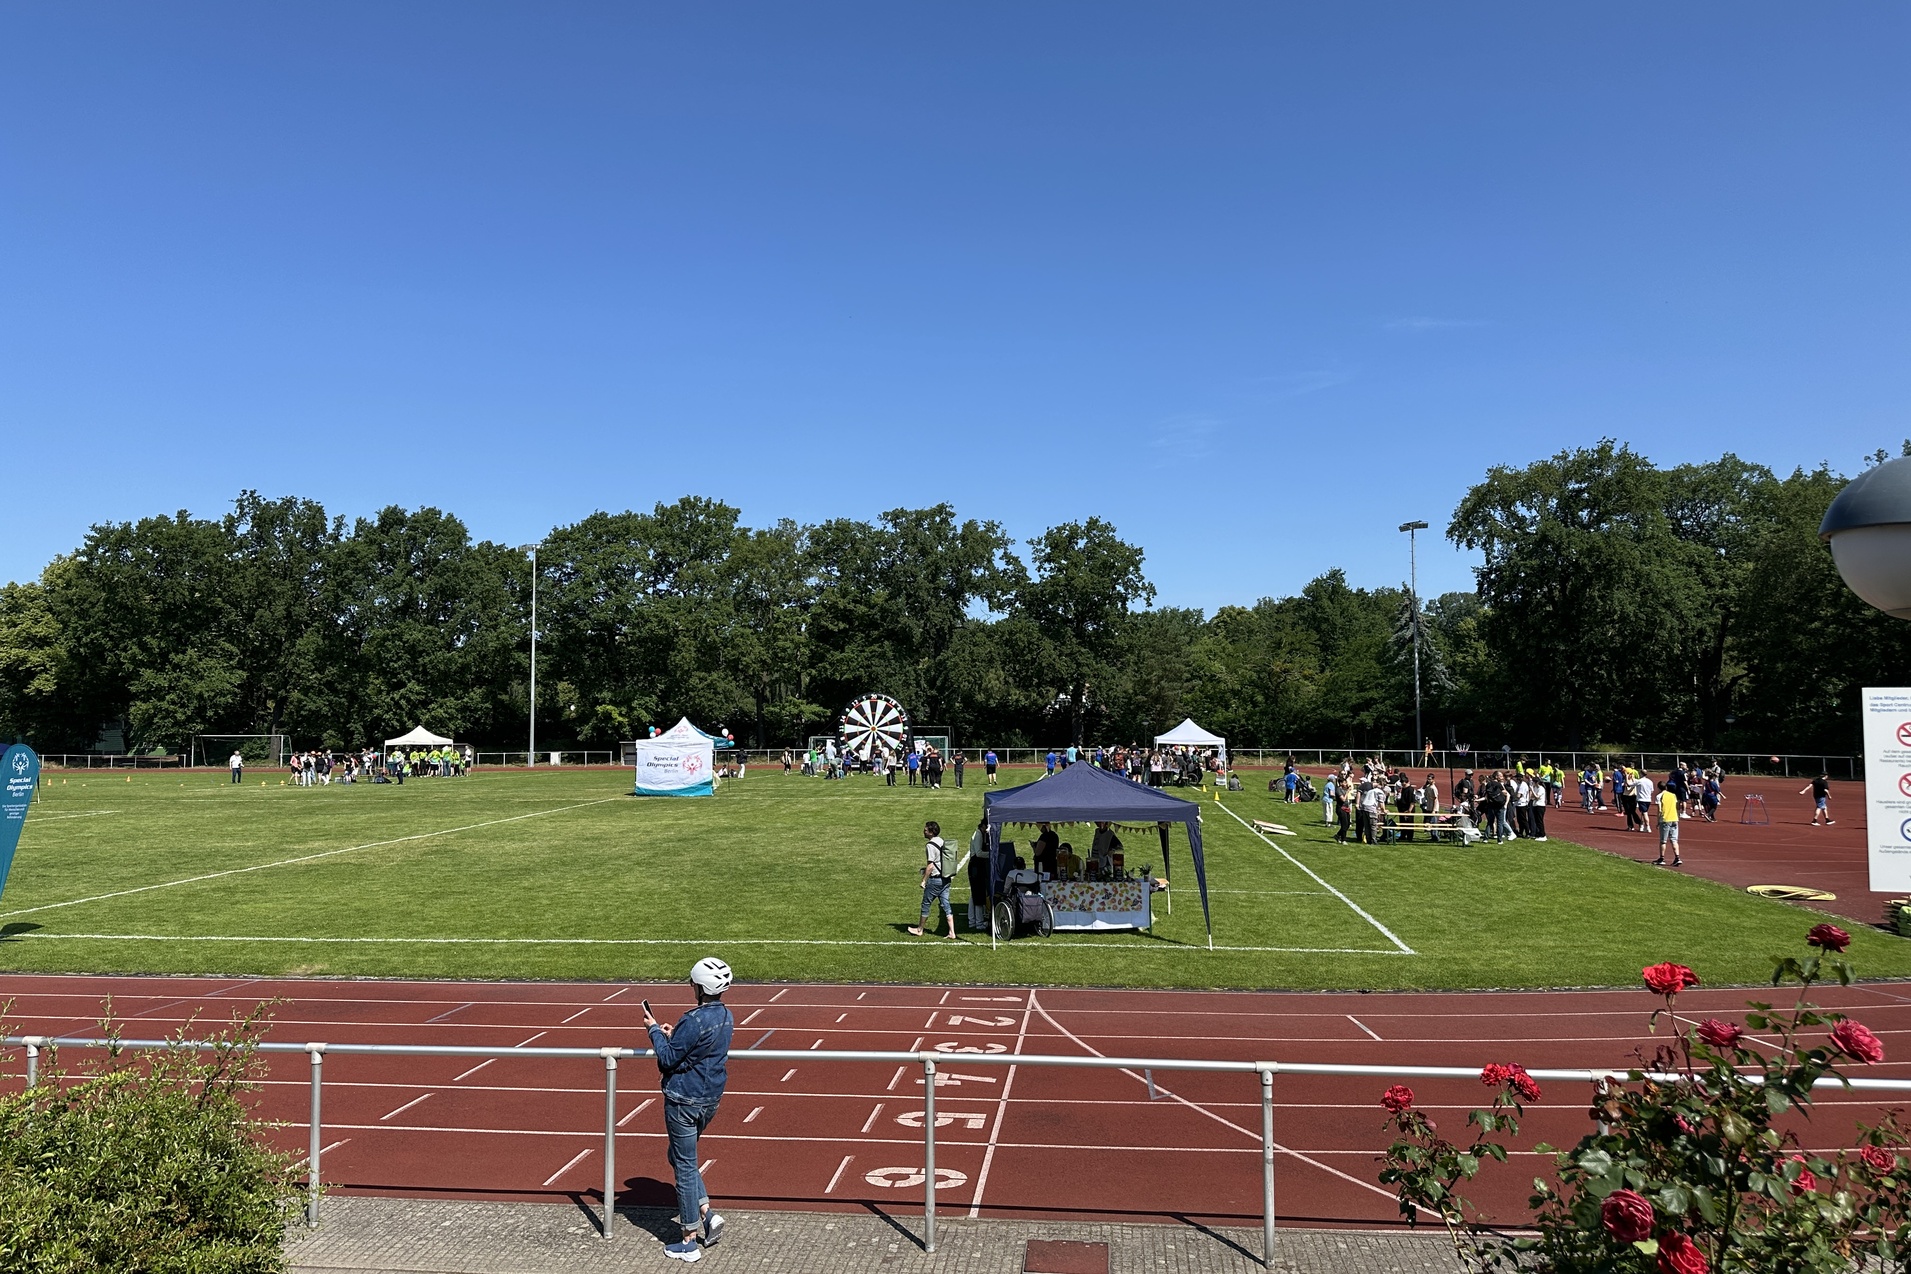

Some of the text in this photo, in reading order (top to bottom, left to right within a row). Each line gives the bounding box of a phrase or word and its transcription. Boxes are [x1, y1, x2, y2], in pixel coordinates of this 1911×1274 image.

[948, 1014, 1016, 1026] 2
[934, 1042, 1008, 1054] 3
[914, 1072, 996, 1086] 4
[894, 1110, 987, 1129] 5
[864, 1166, 968, 1189] 6
